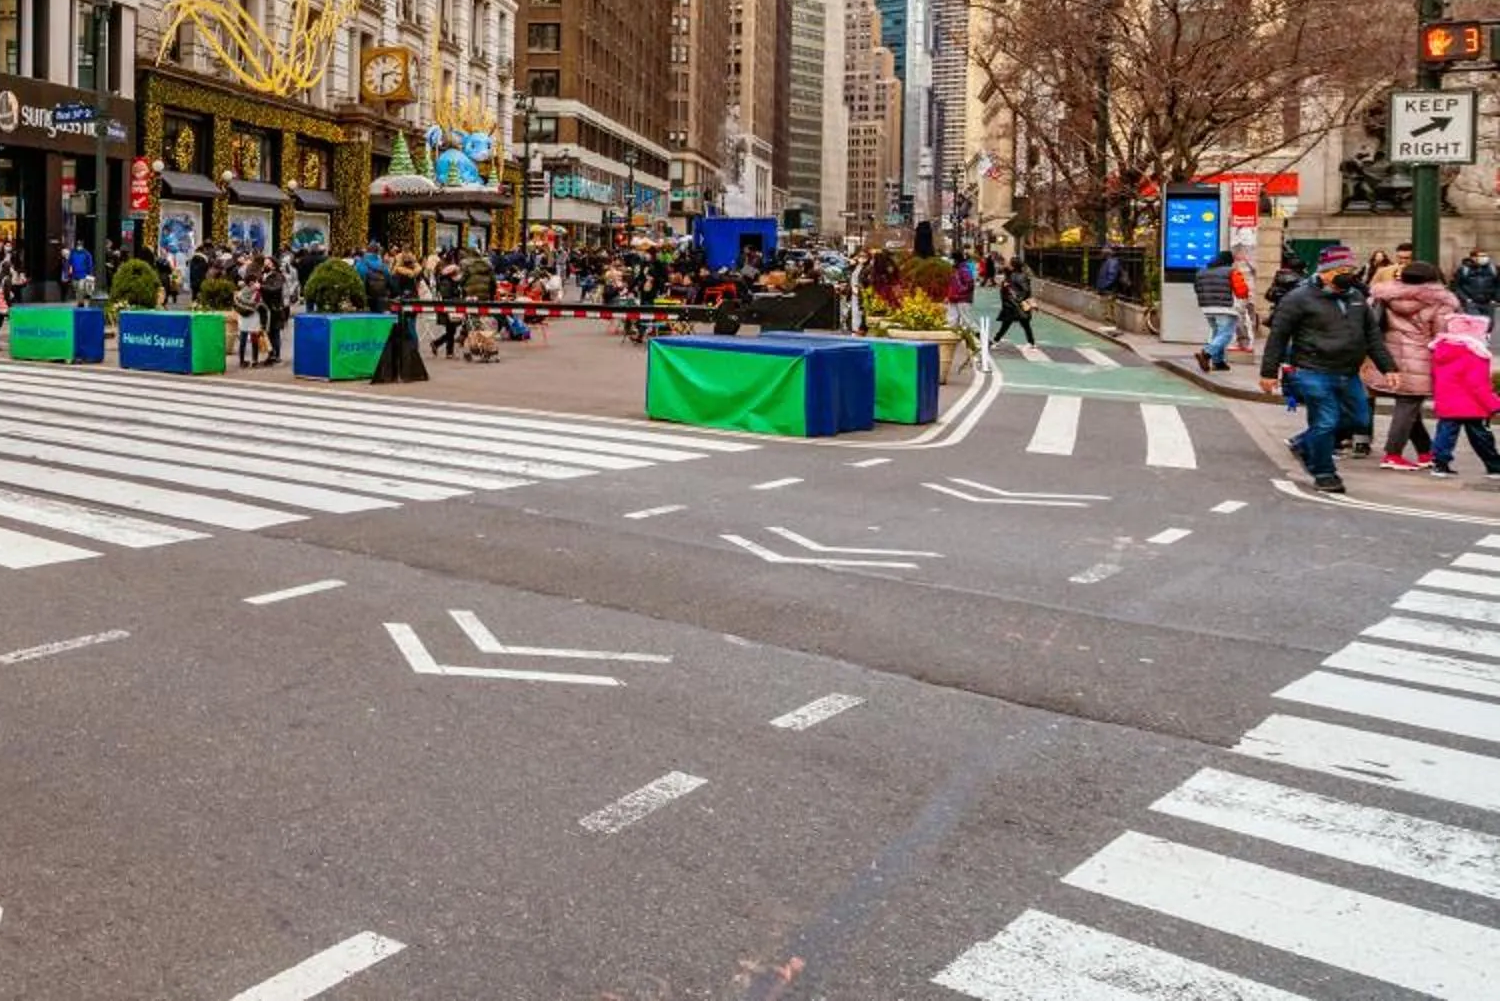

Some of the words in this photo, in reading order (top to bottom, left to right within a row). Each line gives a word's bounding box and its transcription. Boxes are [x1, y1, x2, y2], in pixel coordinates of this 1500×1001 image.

[1404, 98, 1460, 113] KEEP
[1400, 142, 1462, 157] RIGHT
[122, 332, 152, 346] Herald
[153, 335, 185, 349] Square
